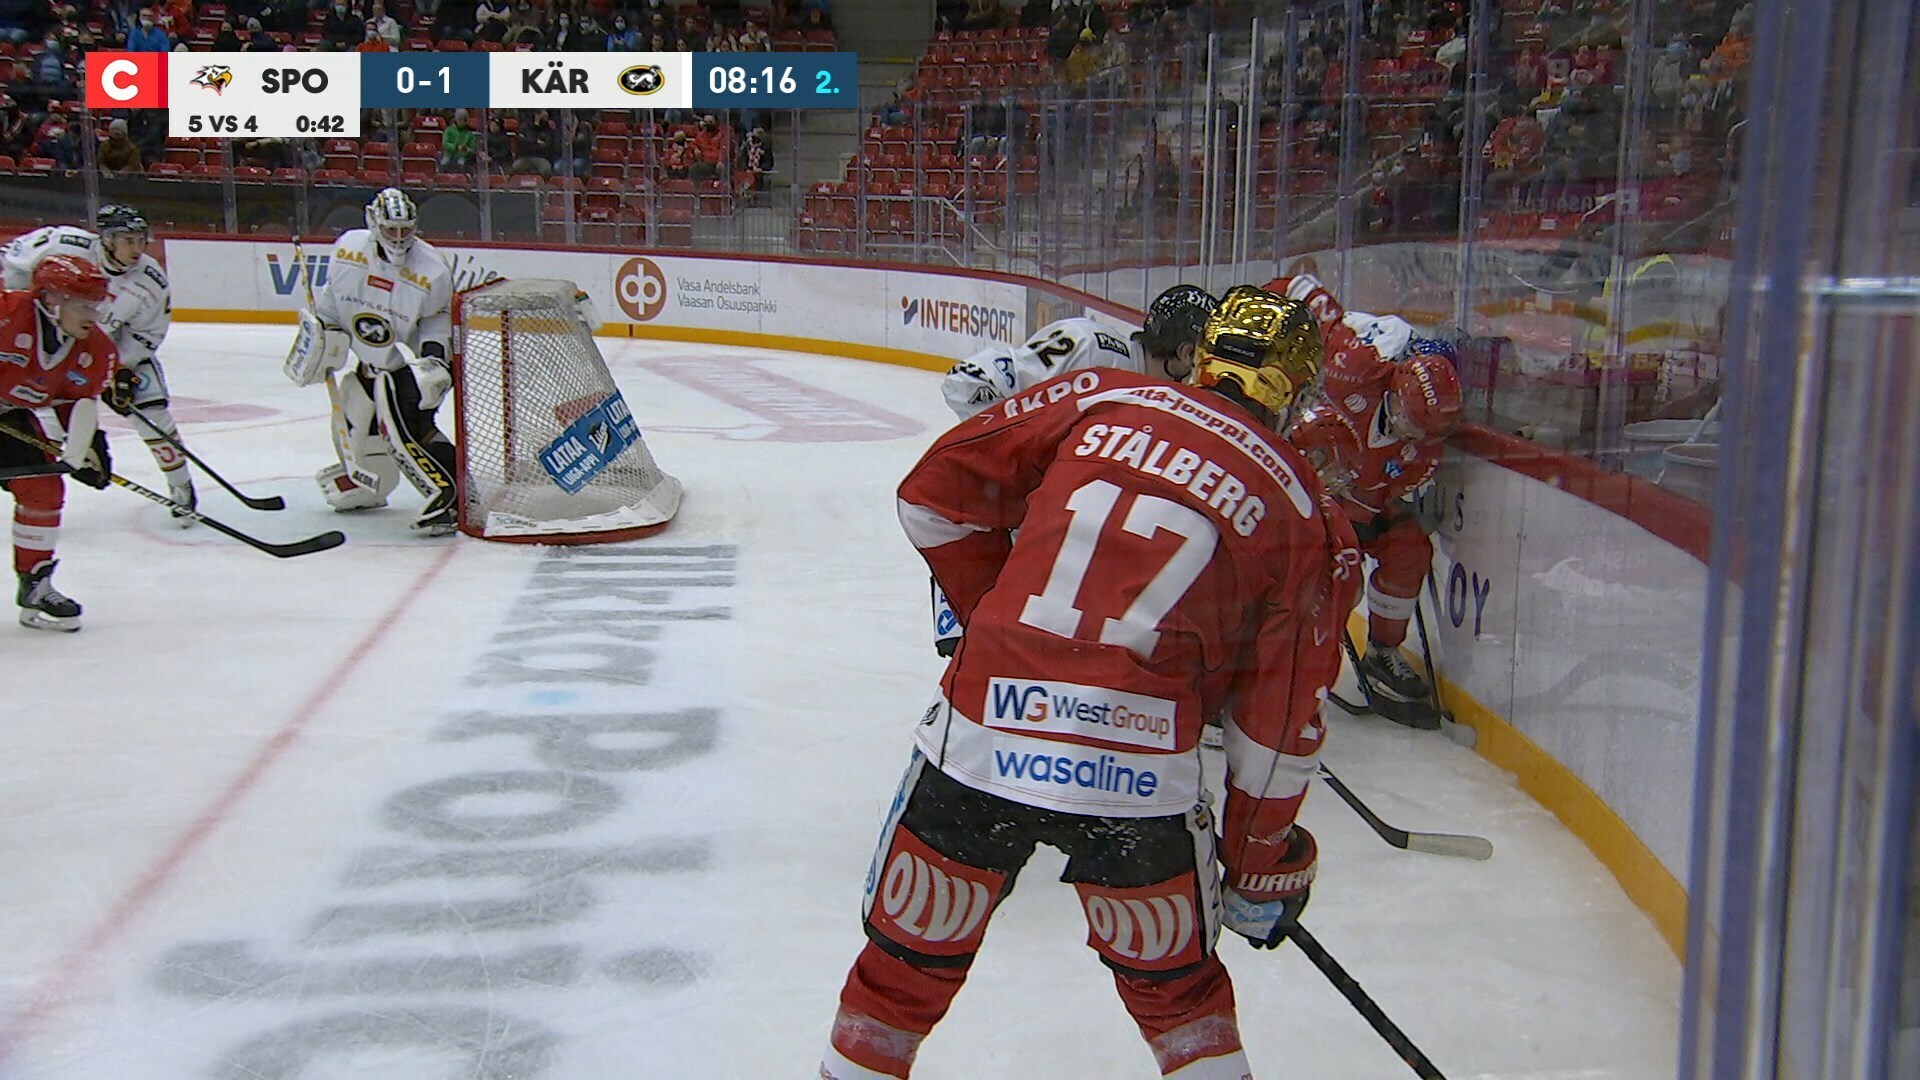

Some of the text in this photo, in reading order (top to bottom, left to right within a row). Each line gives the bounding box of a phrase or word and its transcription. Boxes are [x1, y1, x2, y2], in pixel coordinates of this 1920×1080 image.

[677, 277, 761, 297] Vasa Andelsbank
[678, 293, 777, 314] Vaasan Osuuspankki
[921, 298, 1016, 344] INTERSPORT
[406, 443, 450, 487] CCM
[546, 435, 588, 474] LATAA
[1073, 424, 1267, 538] STÅLBERG
[1018, 479, 1221, 660] 17
[992, 683, 1171, 740] WG WestGroup
[994, 749, 1159, 798] wasaline
[882, 851, 990, 943] OLVI
[1087, 893, 1194, 961] OLVI
